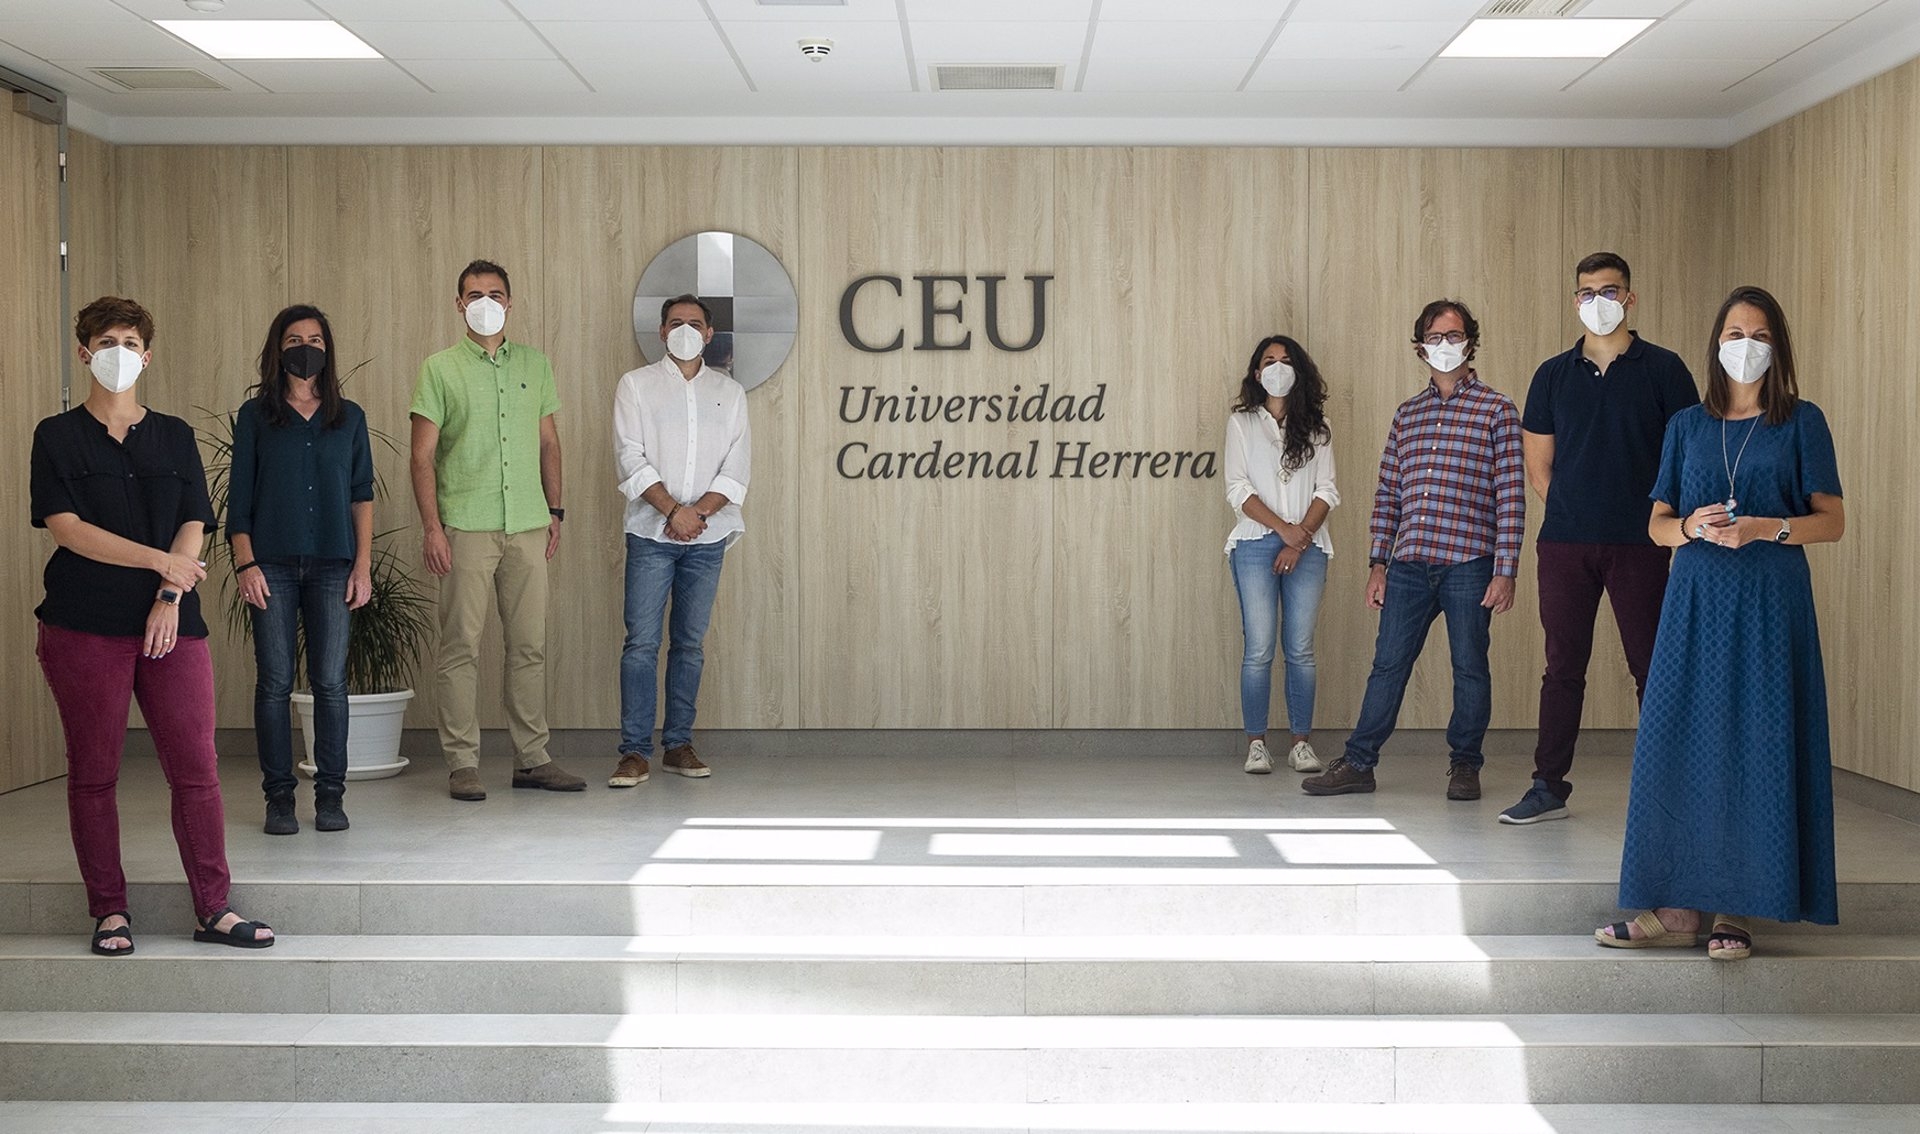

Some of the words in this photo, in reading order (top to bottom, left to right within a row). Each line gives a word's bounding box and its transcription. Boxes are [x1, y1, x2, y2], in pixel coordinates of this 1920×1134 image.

[839, 275, 1055, 353] CEU
[839, 383, 1107, 424] Universidad
[836, 439, 1039, 480] Cardenal
[1049, 441, 1217, 479] Herrera
